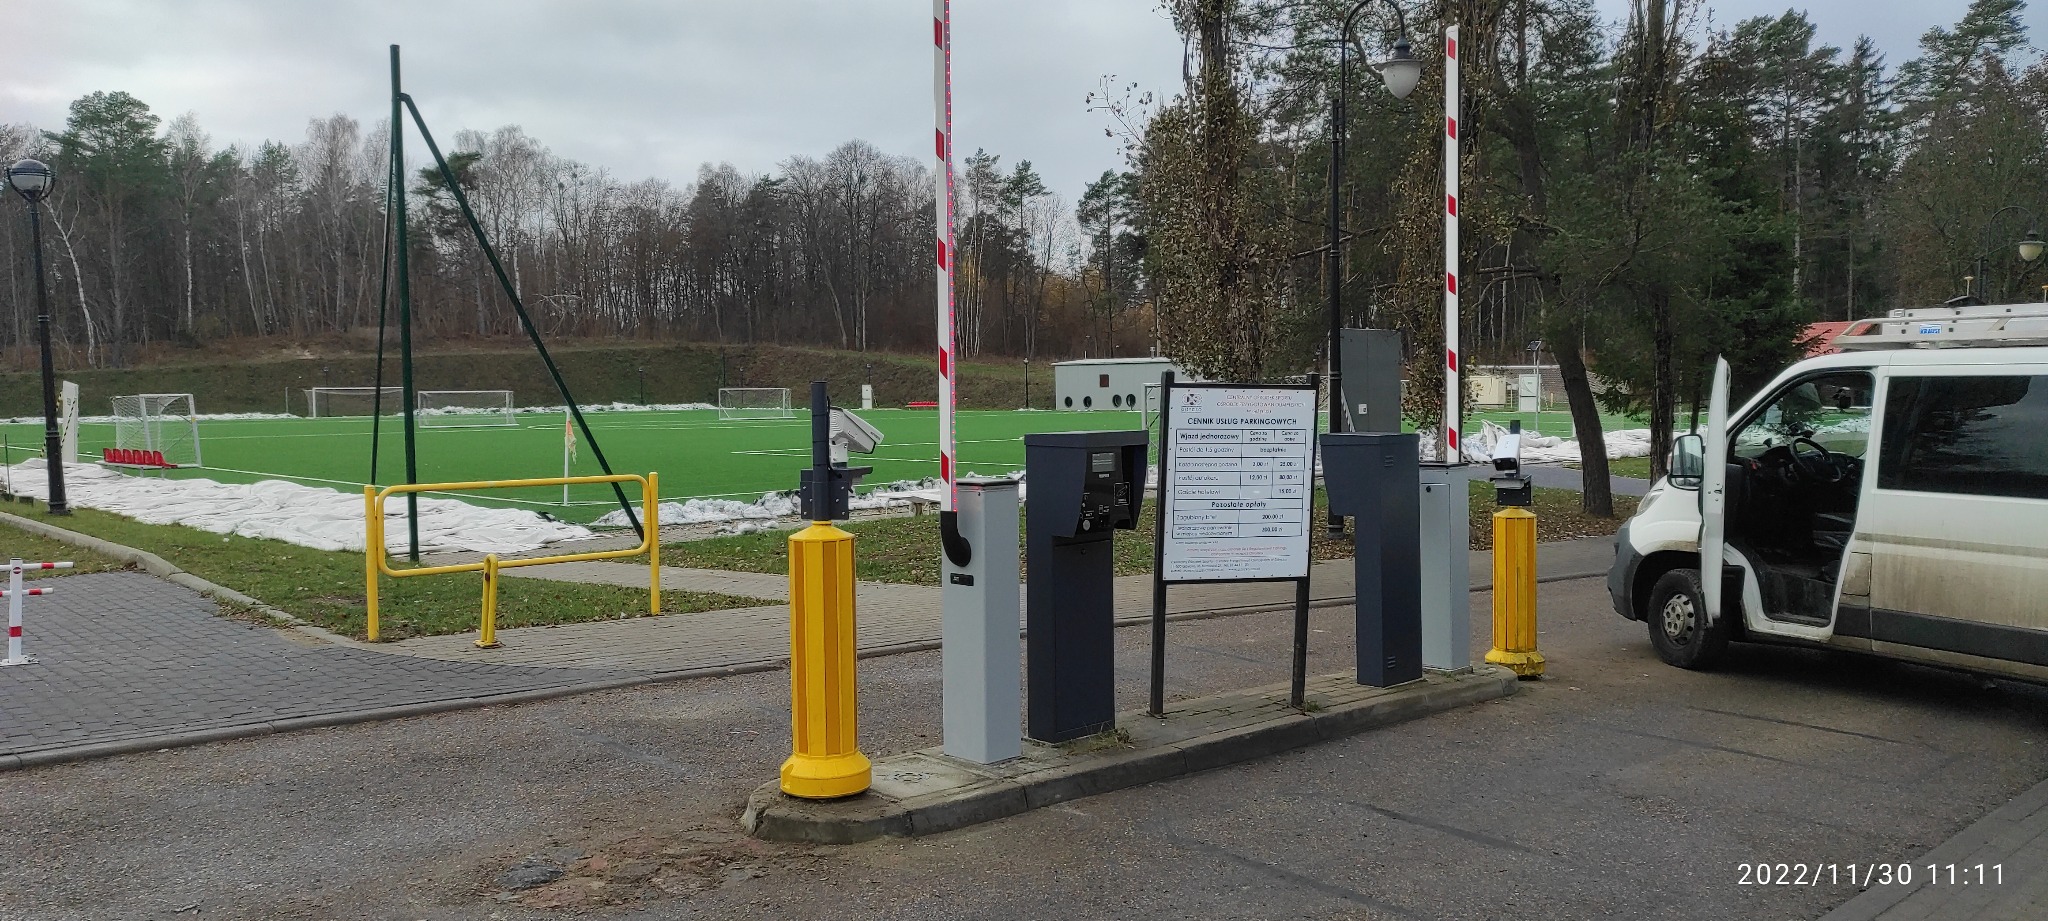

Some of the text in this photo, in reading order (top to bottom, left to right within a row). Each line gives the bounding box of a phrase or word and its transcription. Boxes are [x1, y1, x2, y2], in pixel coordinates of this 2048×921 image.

[1187, 417, 1214, 425] CENNIK
[1200, 433, 1239, 441] jednorazowy
[1246, 501, 1267, 509] opłaty
